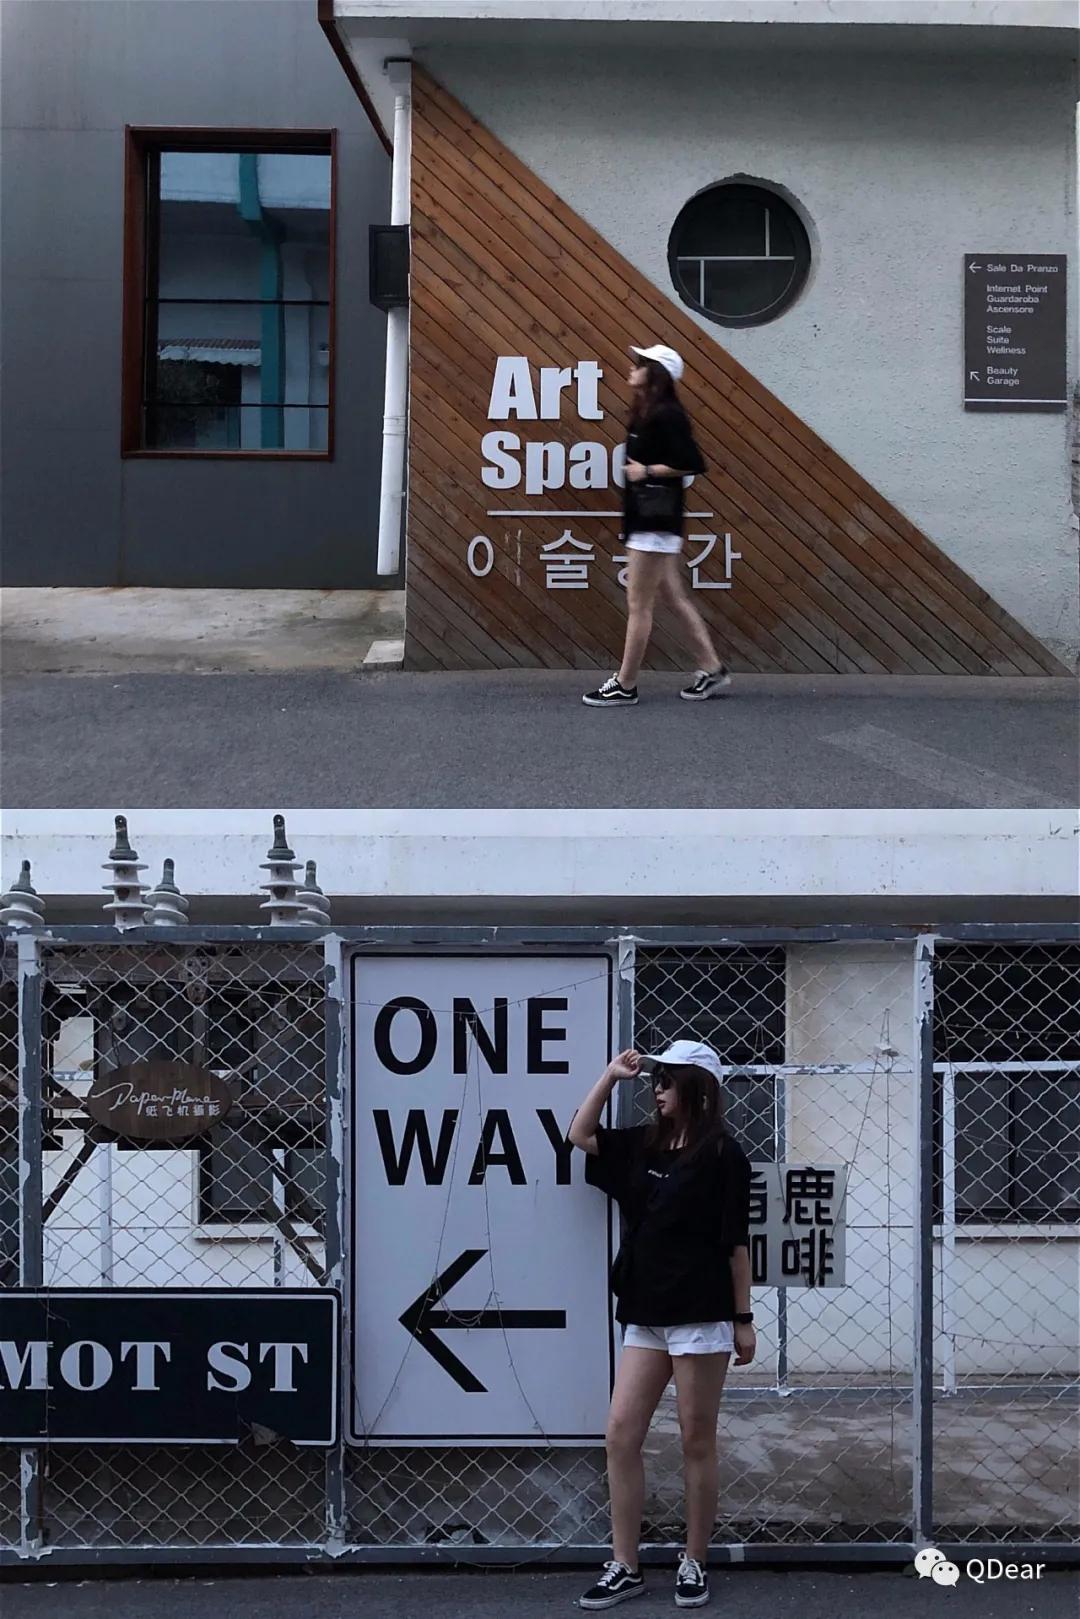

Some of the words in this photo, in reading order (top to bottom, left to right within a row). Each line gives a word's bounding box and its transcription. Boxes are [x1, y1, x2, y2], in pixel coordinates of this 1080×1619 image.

[986, 263, 1007, 273] Sale
[1010, 264, 1023, 273] Da
[1027, 264, 1058, 273] Pranzo
[986, 284, 1021, 293] Internet
[1025, 285, 1048, 293] Point
[986, 294, 1040, 303] Guardaroba
[986, 305, 1034, 313] Ascensore
[986, 325, 1012, 334] Scale
[986, 336, 1009, 344] Suite
[986, 346, 1026, 354] Wellness
[986, 366, 1018, 376] Beauty
[986, 376, 1020, 386] Garage
[487, 356, 603, 420] Art
[481, 431, 695, 495] Spa
[374, 996, 569, 1076] ONE
[373, 1109, 579, 1186] WAY
[0, 1340, 171, 1391] MOT
[207, 1341, 308, 1392] ST
